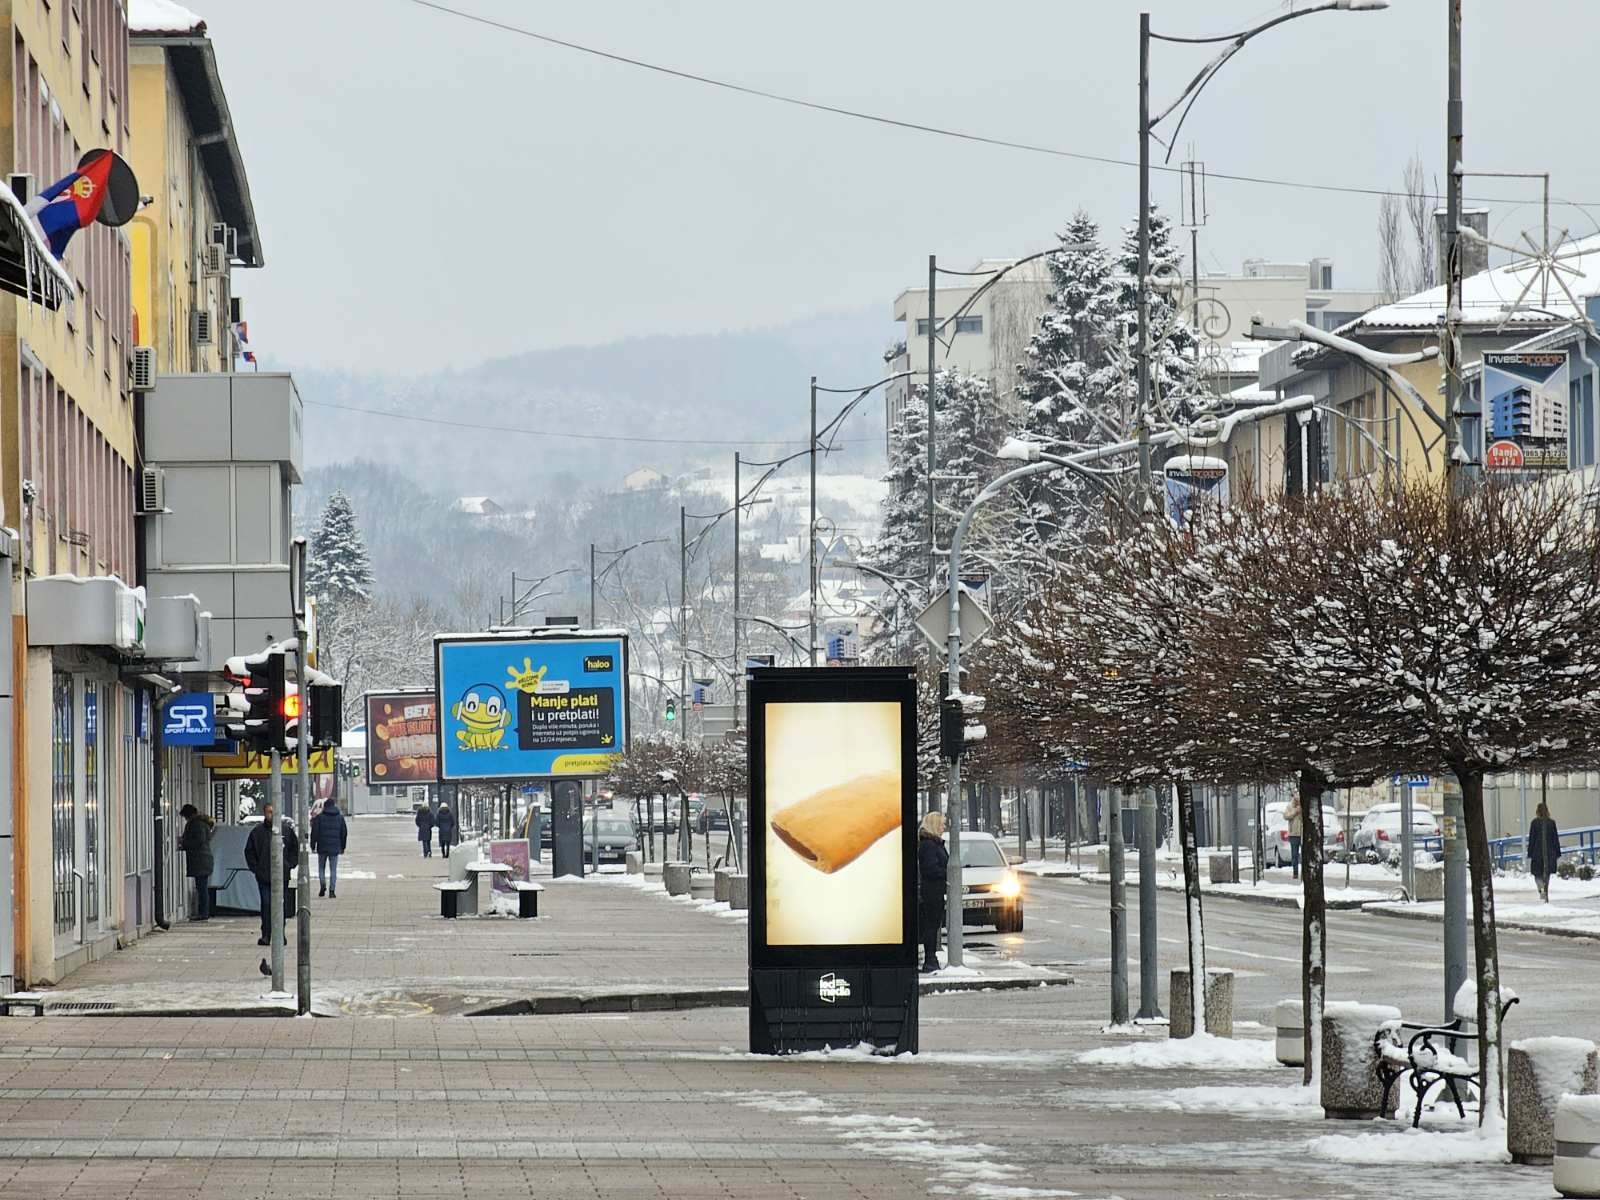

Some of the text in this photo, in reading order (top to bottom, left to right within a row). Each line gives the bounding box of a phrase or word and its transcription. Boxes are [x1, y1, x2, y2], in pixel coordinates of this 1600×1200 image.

[587, 660, 610, 669] haloo
[530, 694, 598, 709] Manje plati
[166, 705, 208, 728] SR
[537, 712, 545, 721] u
[547, 708, 600, 722] pretplati!
[820, 986, 851, 996] media
